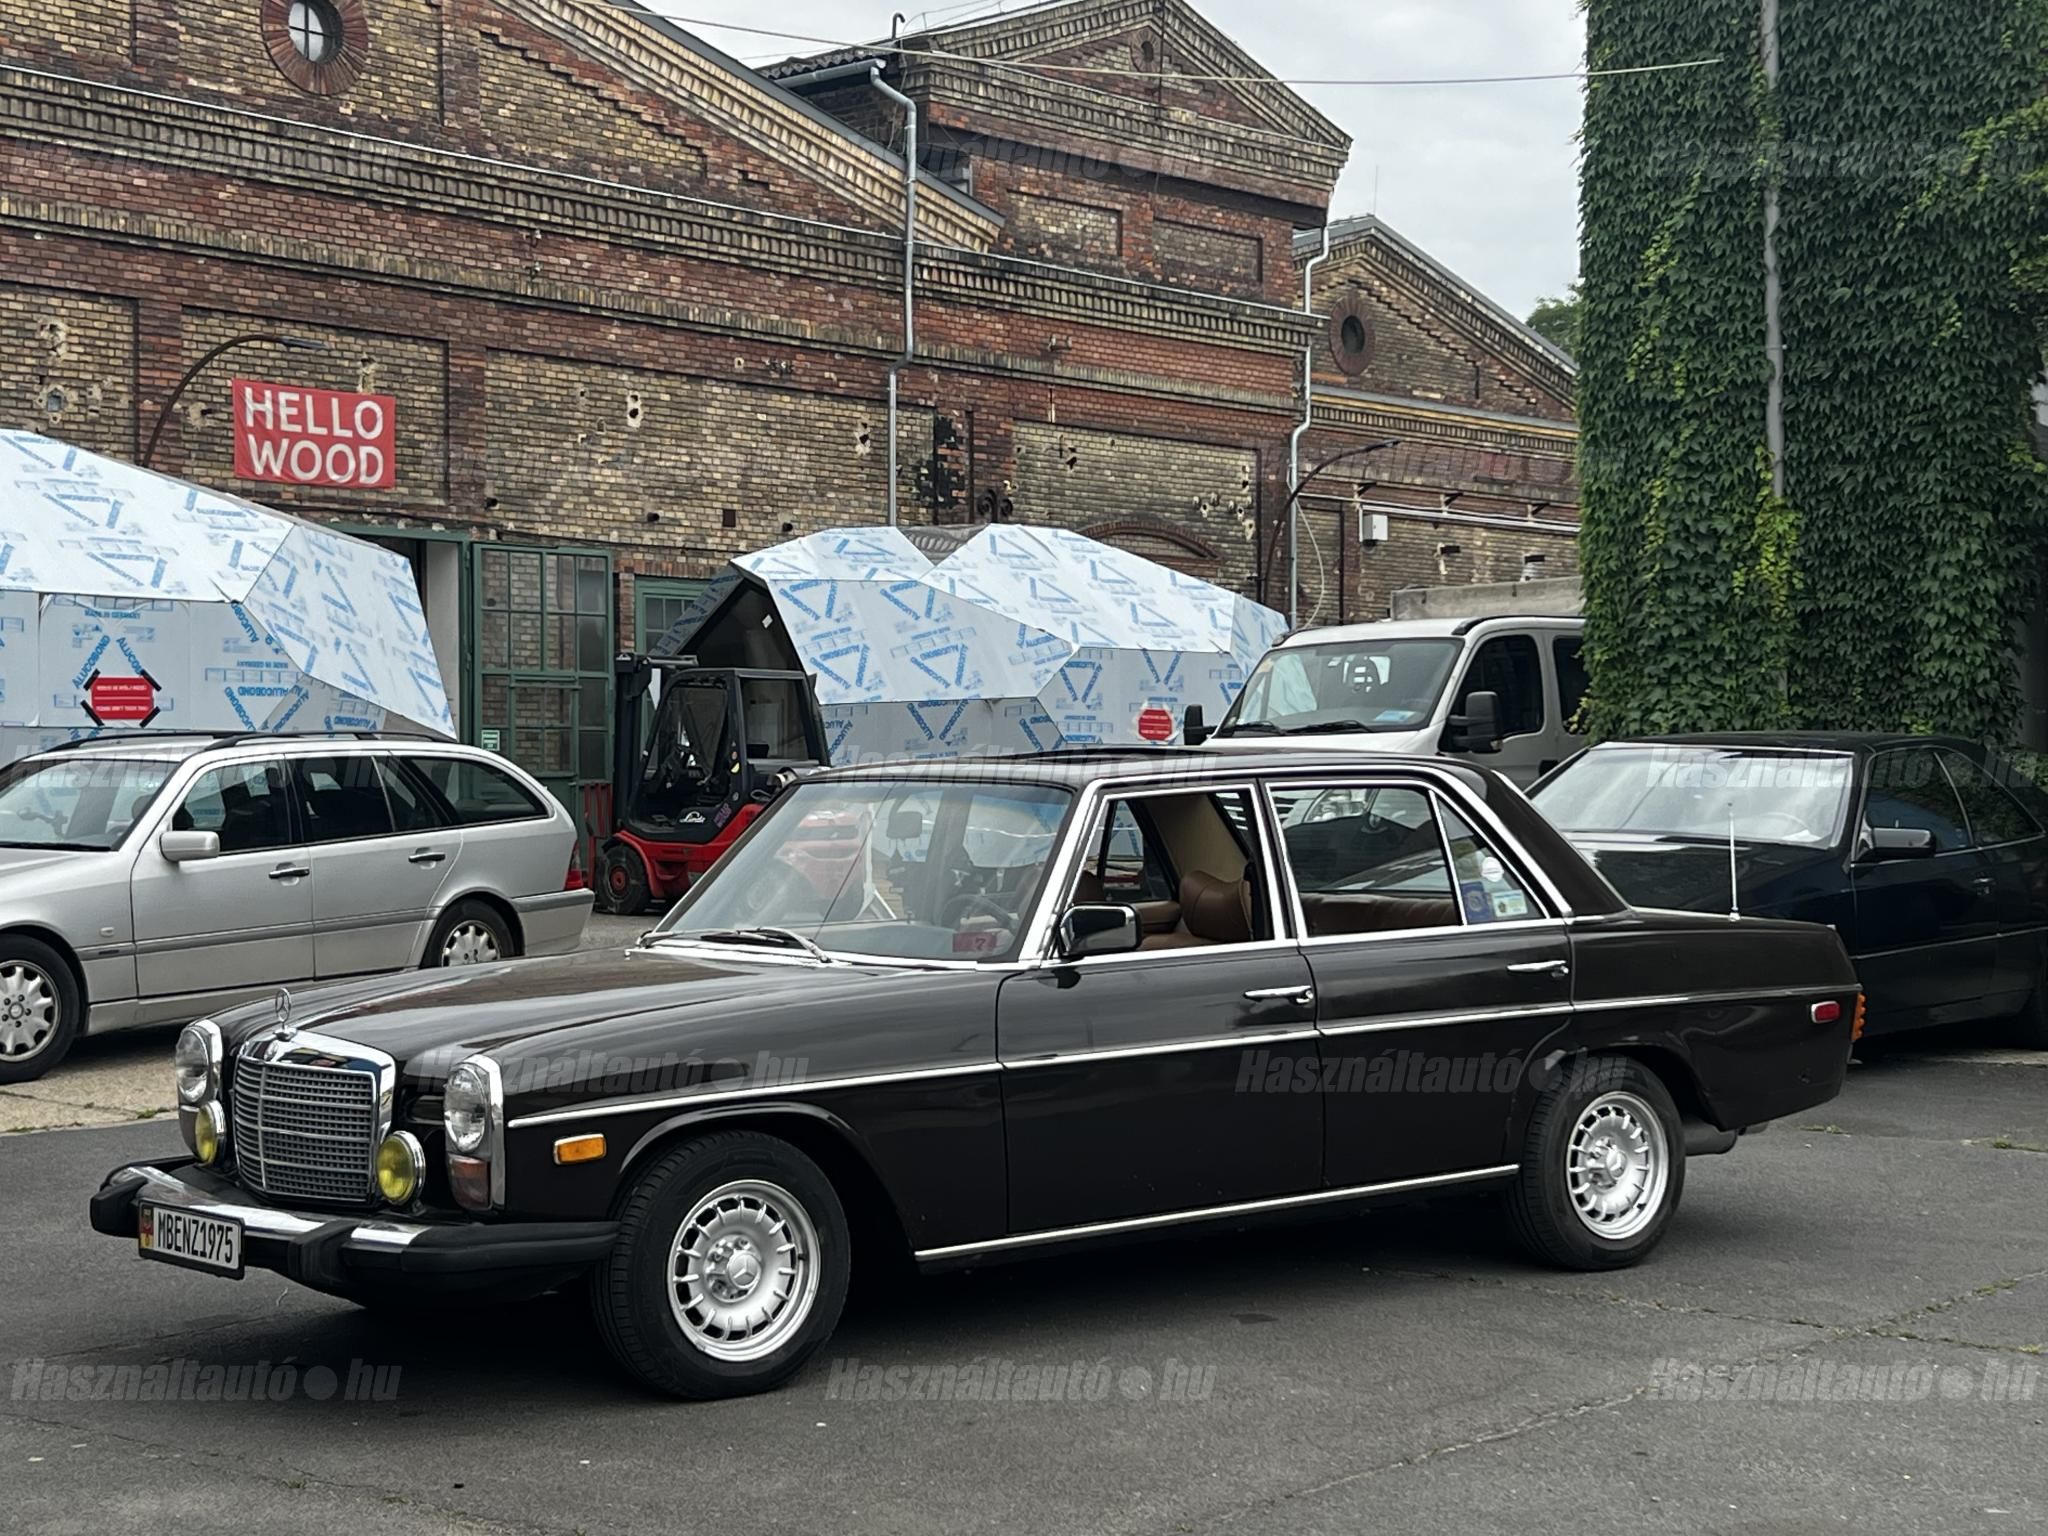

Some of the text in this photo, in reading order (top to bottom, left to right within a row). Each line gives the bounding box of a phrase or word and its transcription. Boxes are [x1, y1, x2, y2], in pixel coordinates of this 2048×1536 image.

[244, 386, 384, 440] HELLO
[247, 434, 384, 485] WOOD
[72, 635, 111, 689] ALUCOBOND
[238, 686, 289, 697] ALUCOBOND
[157, 1211, 233, 1264] MBENZ1975
